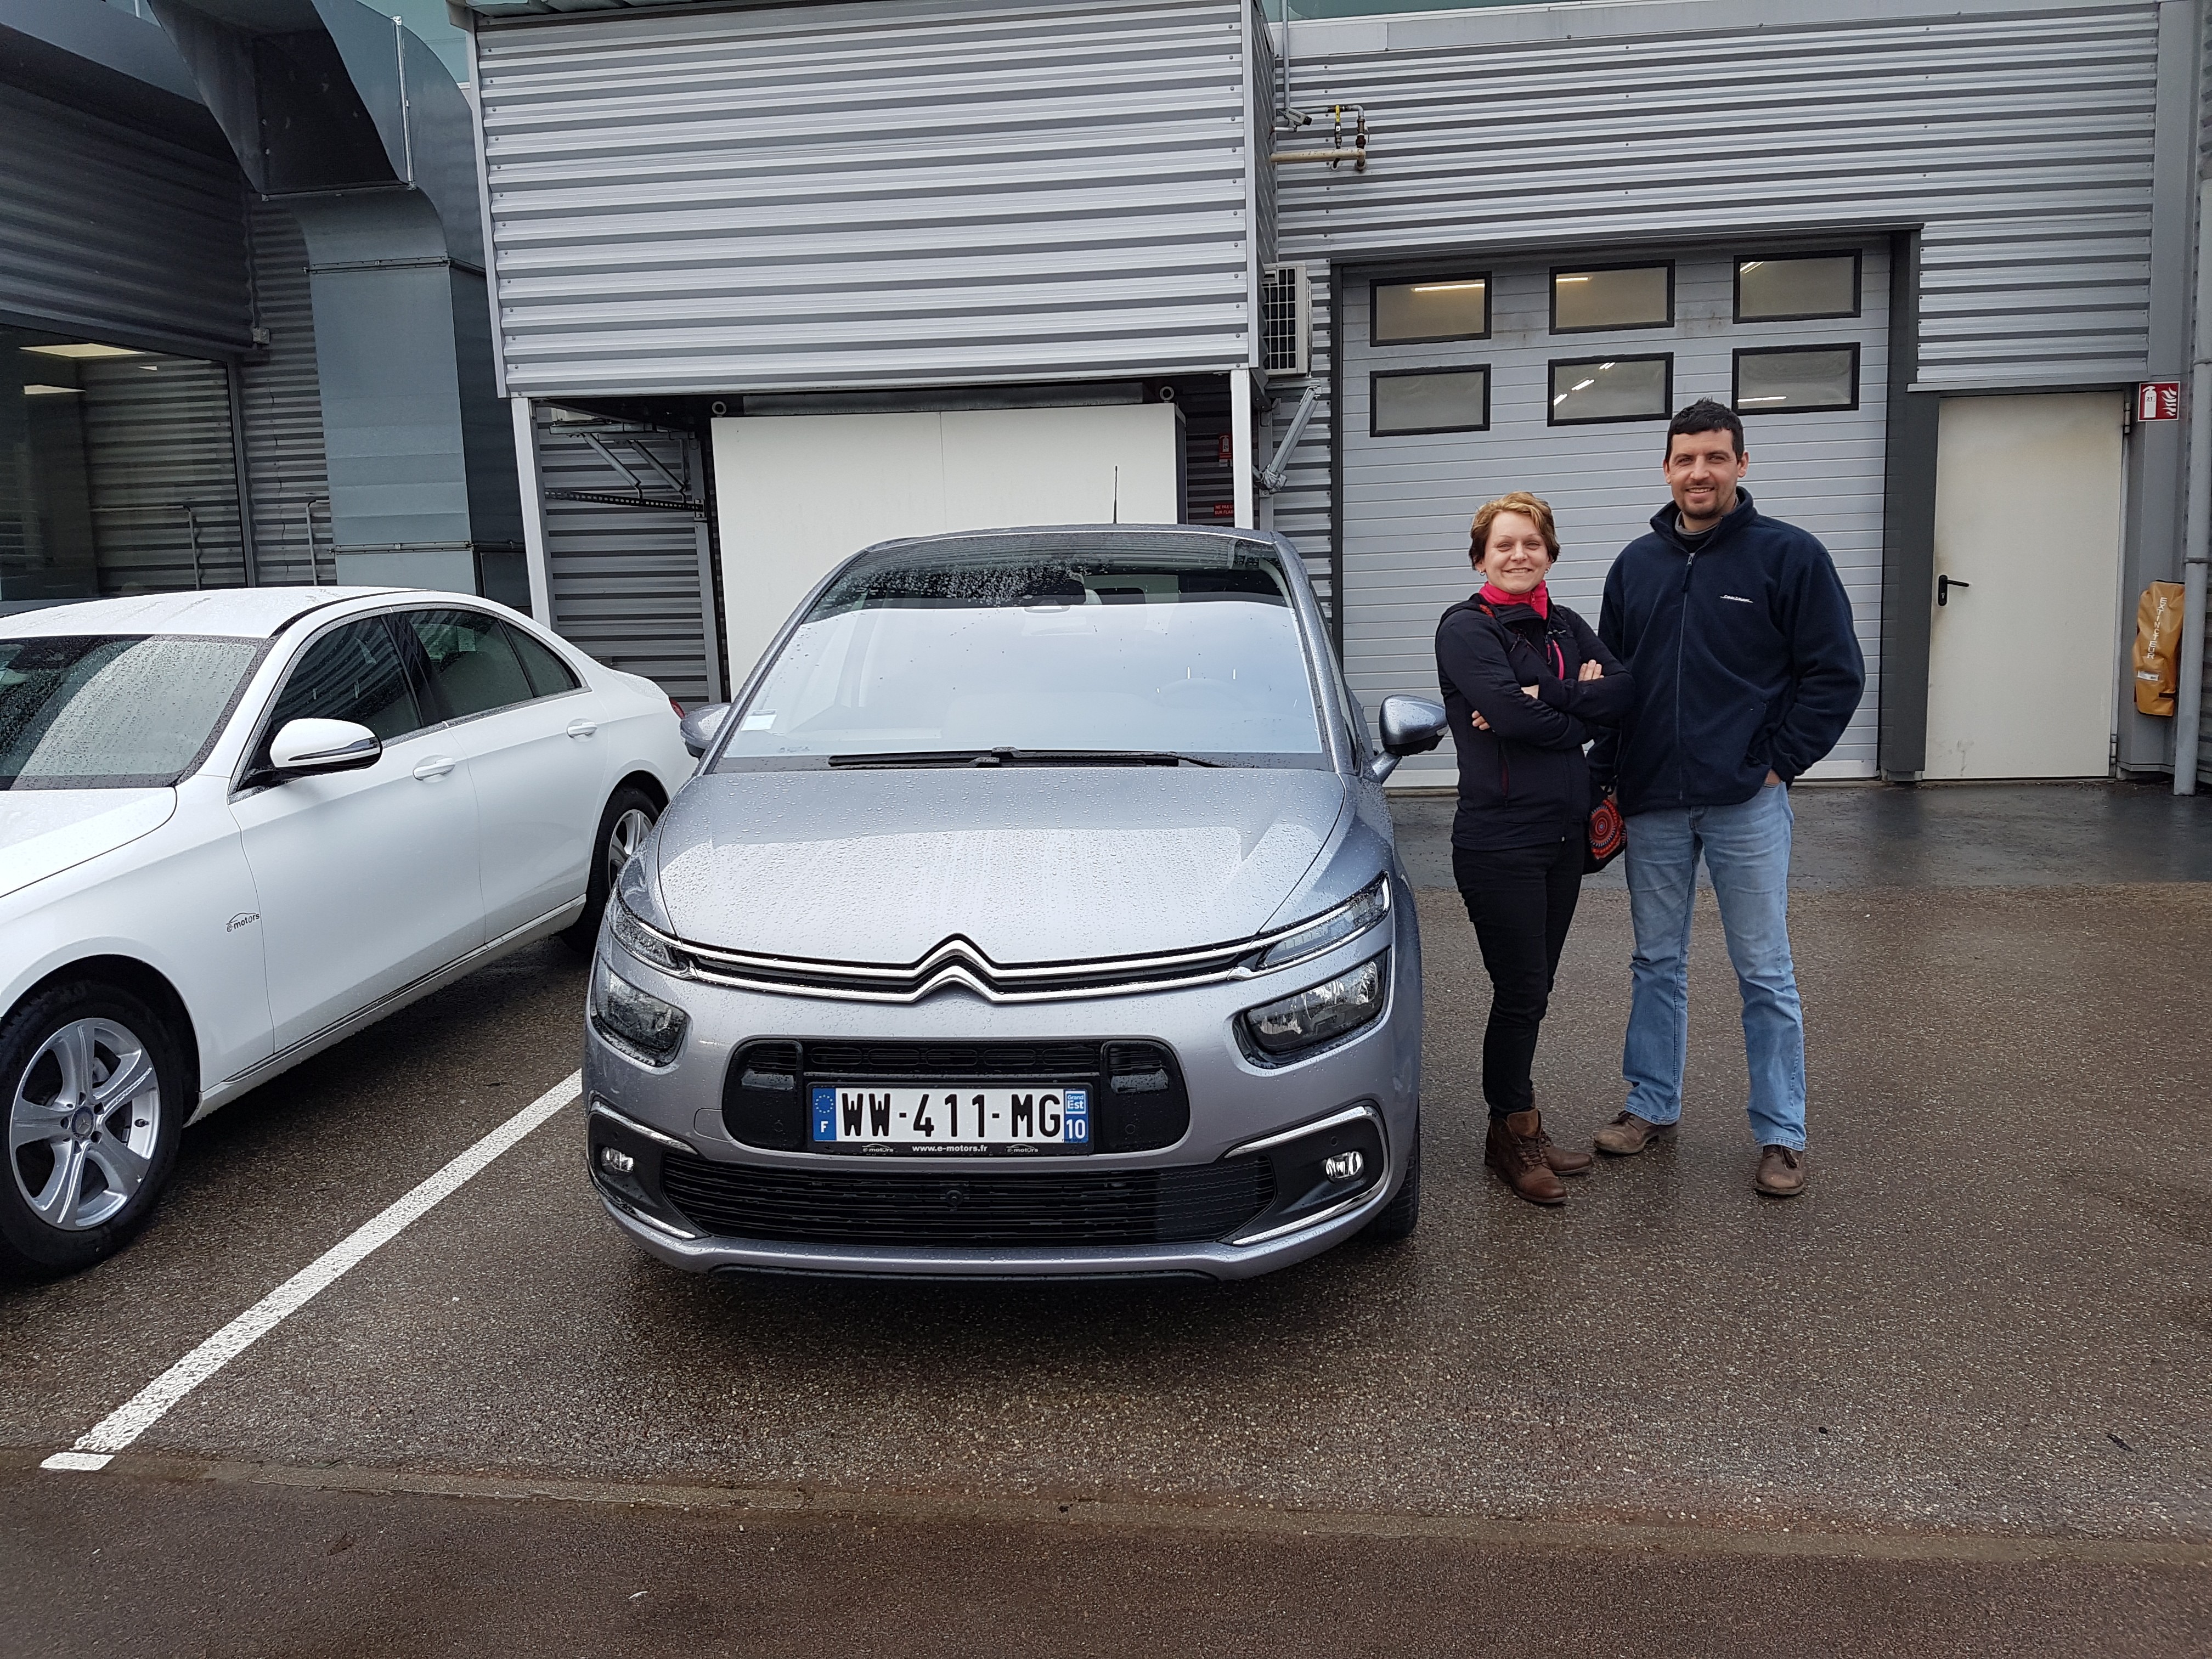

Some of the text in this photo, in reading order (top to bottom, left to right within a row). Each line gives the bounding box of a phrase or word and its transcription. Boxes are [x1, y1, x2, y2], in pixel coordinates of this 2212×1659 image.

[2147, 597, 2167, 659] EXTINCTEUR
[1067, 1100, 1084, 1109] Est
[842, 1093, 1060, 1137] WW-411-MG
[821, 1121, 828, 1133] F
[1066, 1119, 1086, 1139] 10
